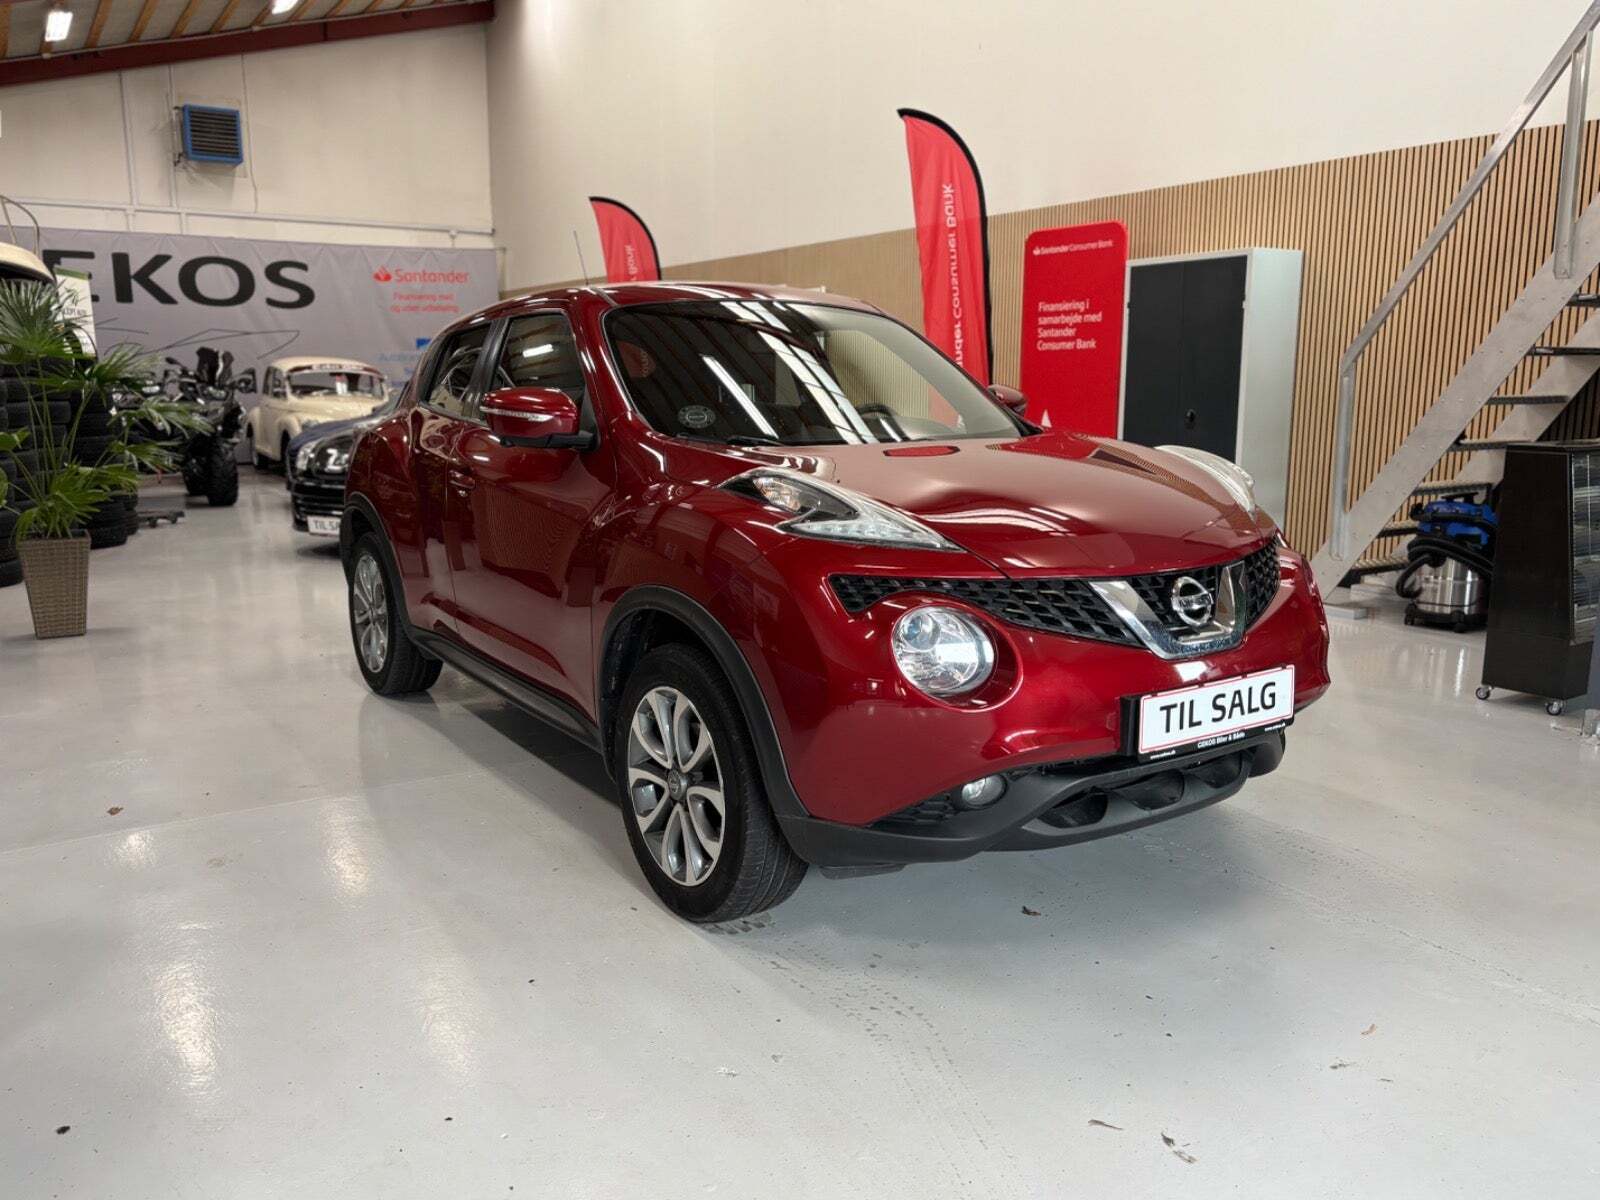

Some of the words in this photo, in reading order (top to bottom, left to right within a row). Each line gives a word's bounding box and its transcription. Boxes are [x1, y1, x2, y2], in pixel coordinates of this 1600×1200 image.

[1098, 239, 1113, 249] Bank
[395, 268, 469, 283] Santander
[1038, 300, 1085, 313] Finansiering
[1038, 313, 1083, 326] samarbejde
[1083, 311, 1102, 323] med
[1037, 327, 1076, 338] Santander
[1036, 340, 1075, 351] Consumer
[1076, 338, 1097, 349] Bank
[328, 520, 340, 531] SA
[1160, 698, 1202, 733] TIL
[1211, 682, 1276, 723] SALG
